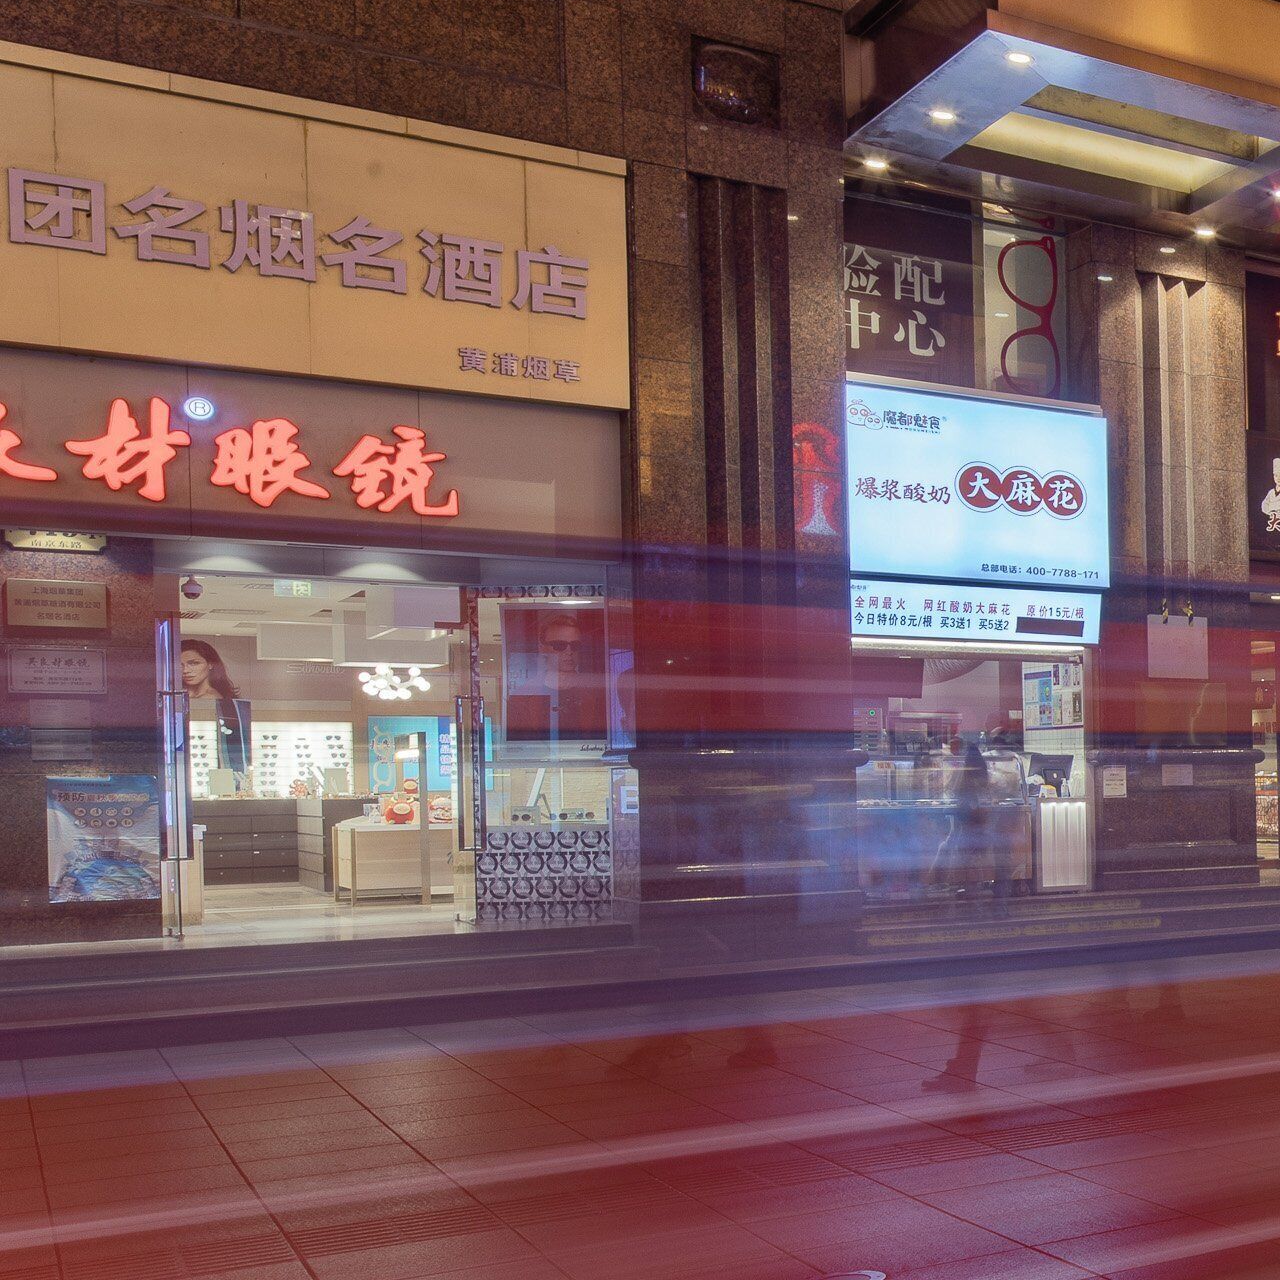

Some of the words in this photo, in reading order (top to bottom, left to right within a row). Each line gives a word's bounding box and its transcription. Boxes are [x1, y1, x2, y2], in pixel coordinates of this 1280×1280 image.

[7, 167, 590, 320] 团名烟名酒店
[844, 299, 945, 358] 中心
[458, 347, 582, 384] 黄浦烟草
[883, 410, 941, 430] 魔都魅食
[854, 476, 951, 505] 爆浆酸奶
[966, 471, 1079, 510] 大麻花
[1025, 567, 1100, 580] 400-7788-171
[854, 595, 906, 611] 全网最火
[923, 599, 1011, 614] 网红酸奶大麻花
[1026, 605, 1084, 619] 原价15元/根
[854, 612, 932, 628] 今日特价8元/根
[940, 616, 971, 629] 买3送1
[978, 618, 1009, 631] 买5送2
